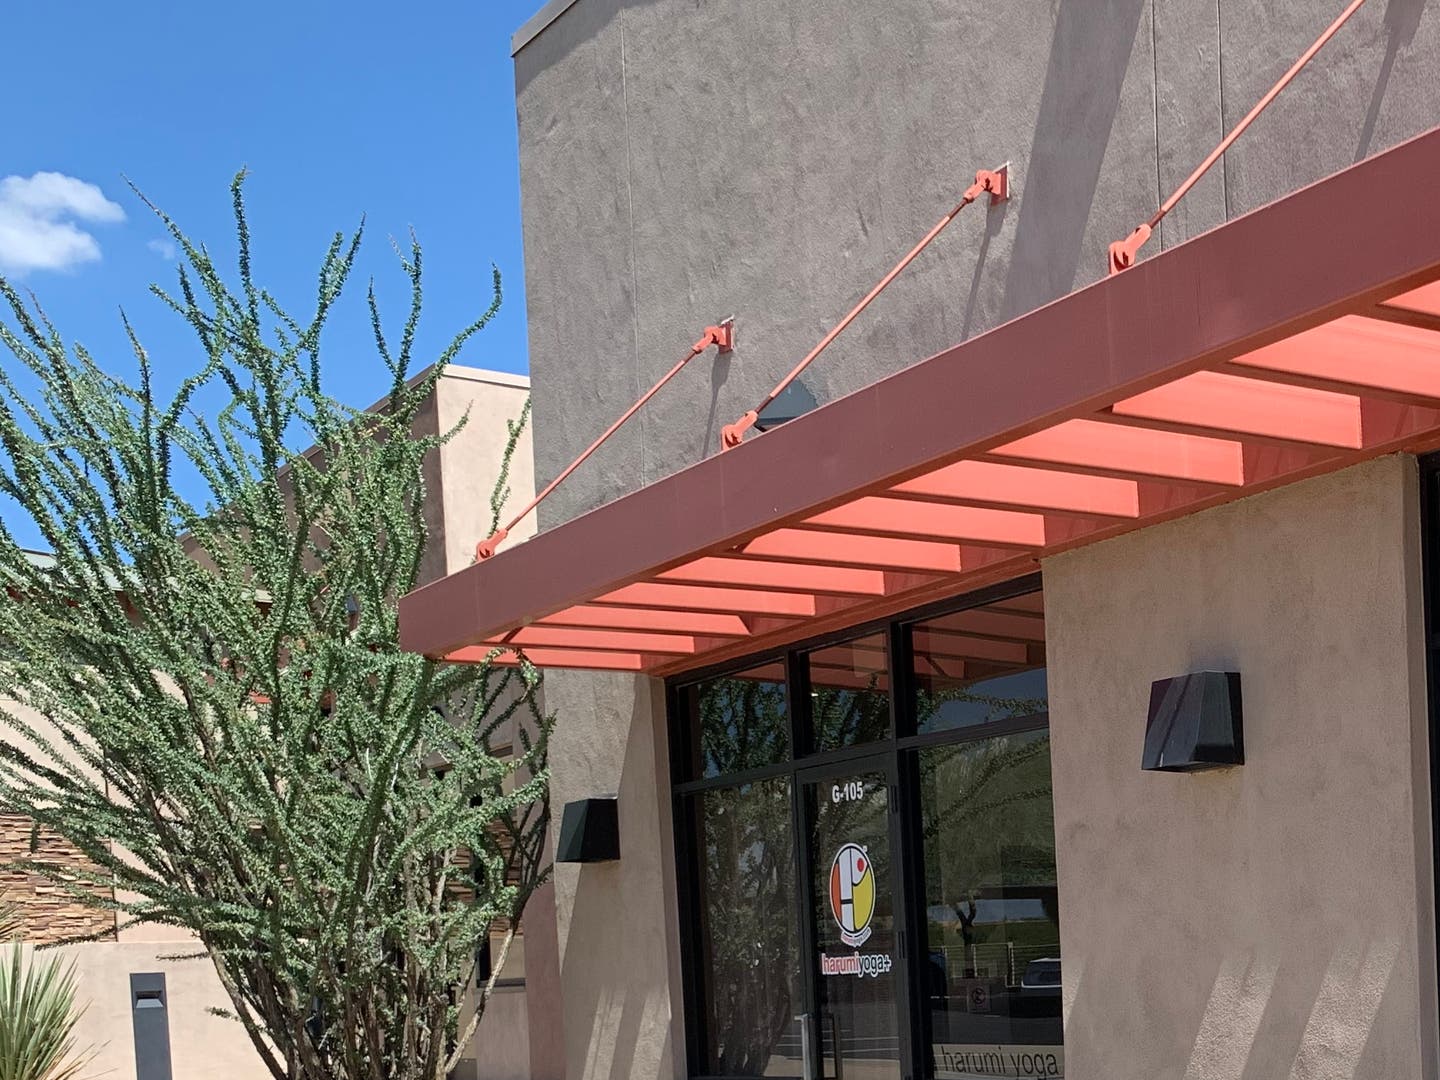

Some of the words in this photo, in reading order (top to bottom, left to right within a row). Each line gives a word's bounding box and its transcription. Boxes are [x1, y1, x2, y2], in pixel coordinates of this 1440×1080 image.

[832, 781, 864, 803] G-105
[822, 952, 891, 977] harumiyoga+
[941, 1046, 1006, 1074] harumi
[1010, 1052, 1060, 1080] yoga
